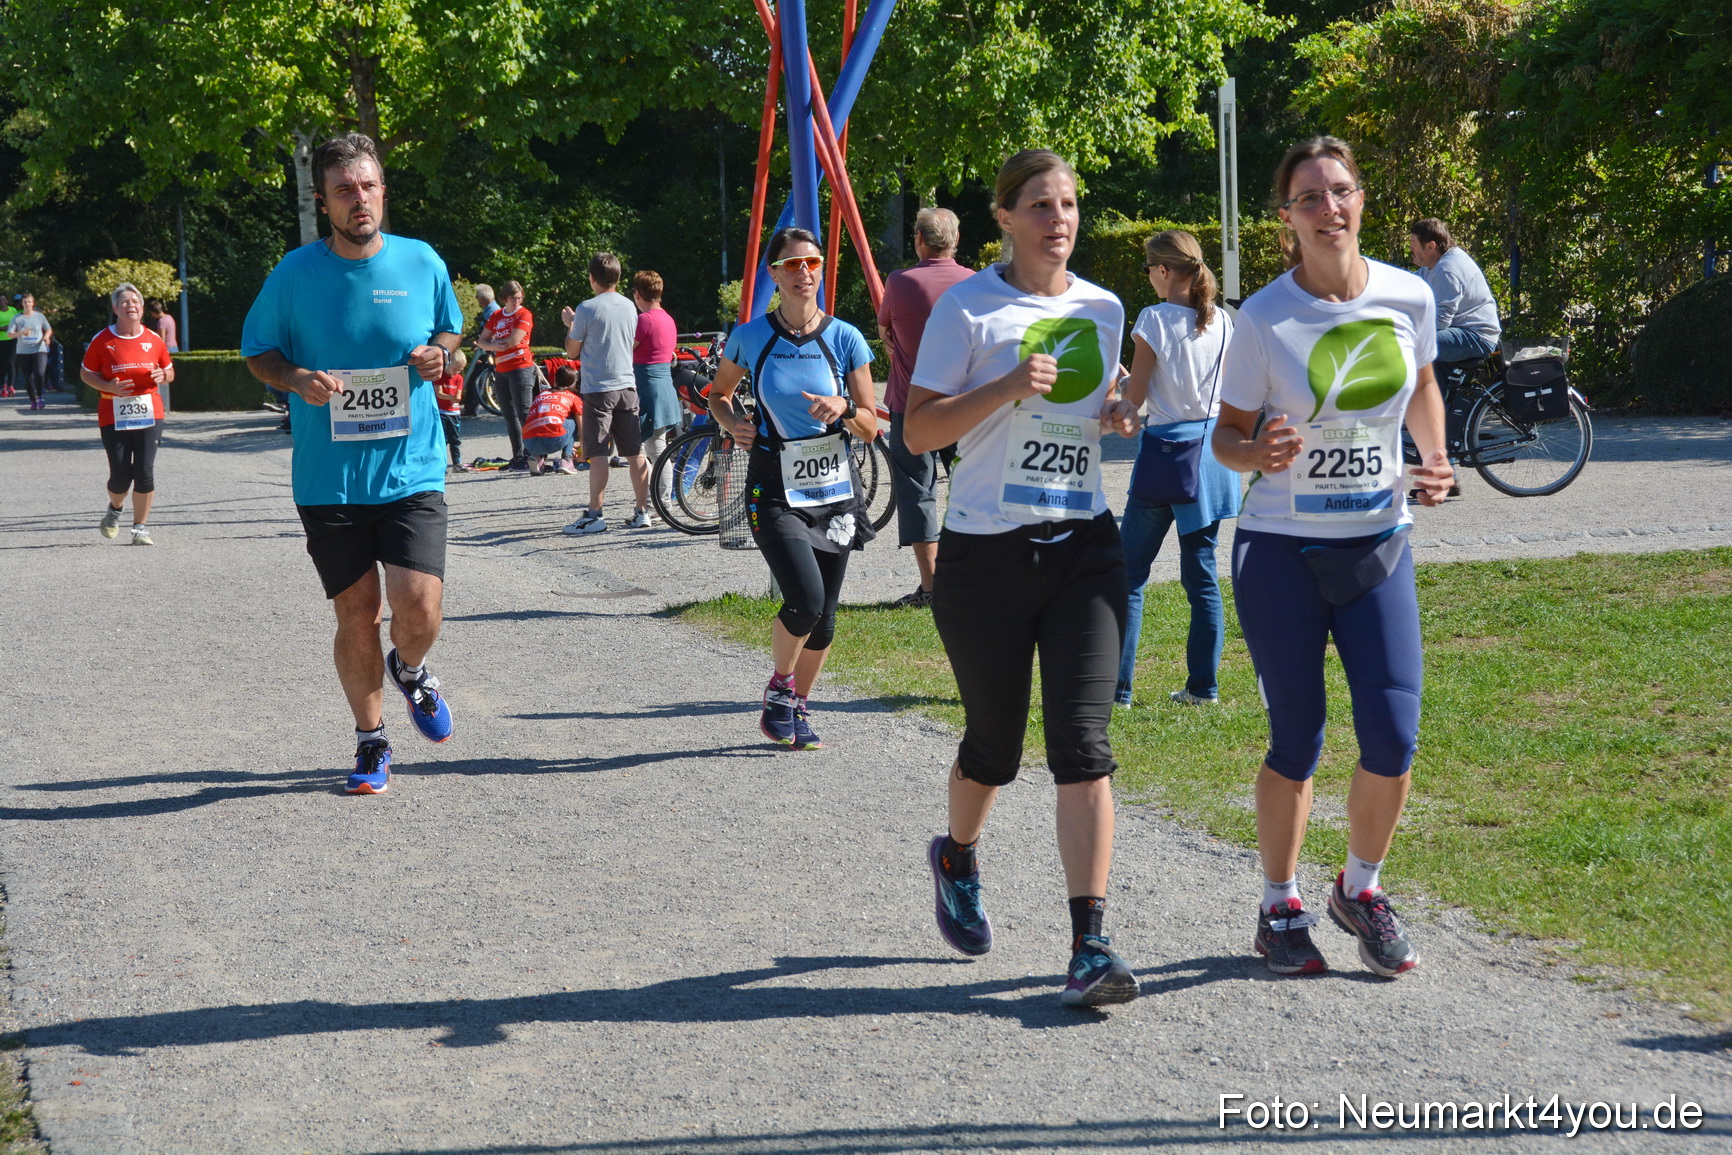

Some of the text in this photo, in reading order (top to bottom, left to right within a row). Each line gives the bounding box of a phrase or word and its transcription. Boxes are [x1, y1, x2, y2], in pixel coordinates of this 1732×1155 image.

[352, 374, 387, 383] BOCK
[342, 386, 398, 411] 2483
[119, 404, 148, 415] 2339
[358, 421, 386, 432] Bernd
[1041, 423, 1082, 436] BOCK
[1323, 427, 1369, 439] BOCK
[802, 443, 831, 455] BOCK
[1021, 440, 1089, 476] 2256
[1308, 446, 1382, 478] 2255
[793, 453, 840, 480] 2094
[1026, 475, 1047, 483] PARTL
[804, 487, 836, 500] Barbara
[1038, 491, 1069, 506] Anna
[1324, 497, 1370, 510] Andrea
